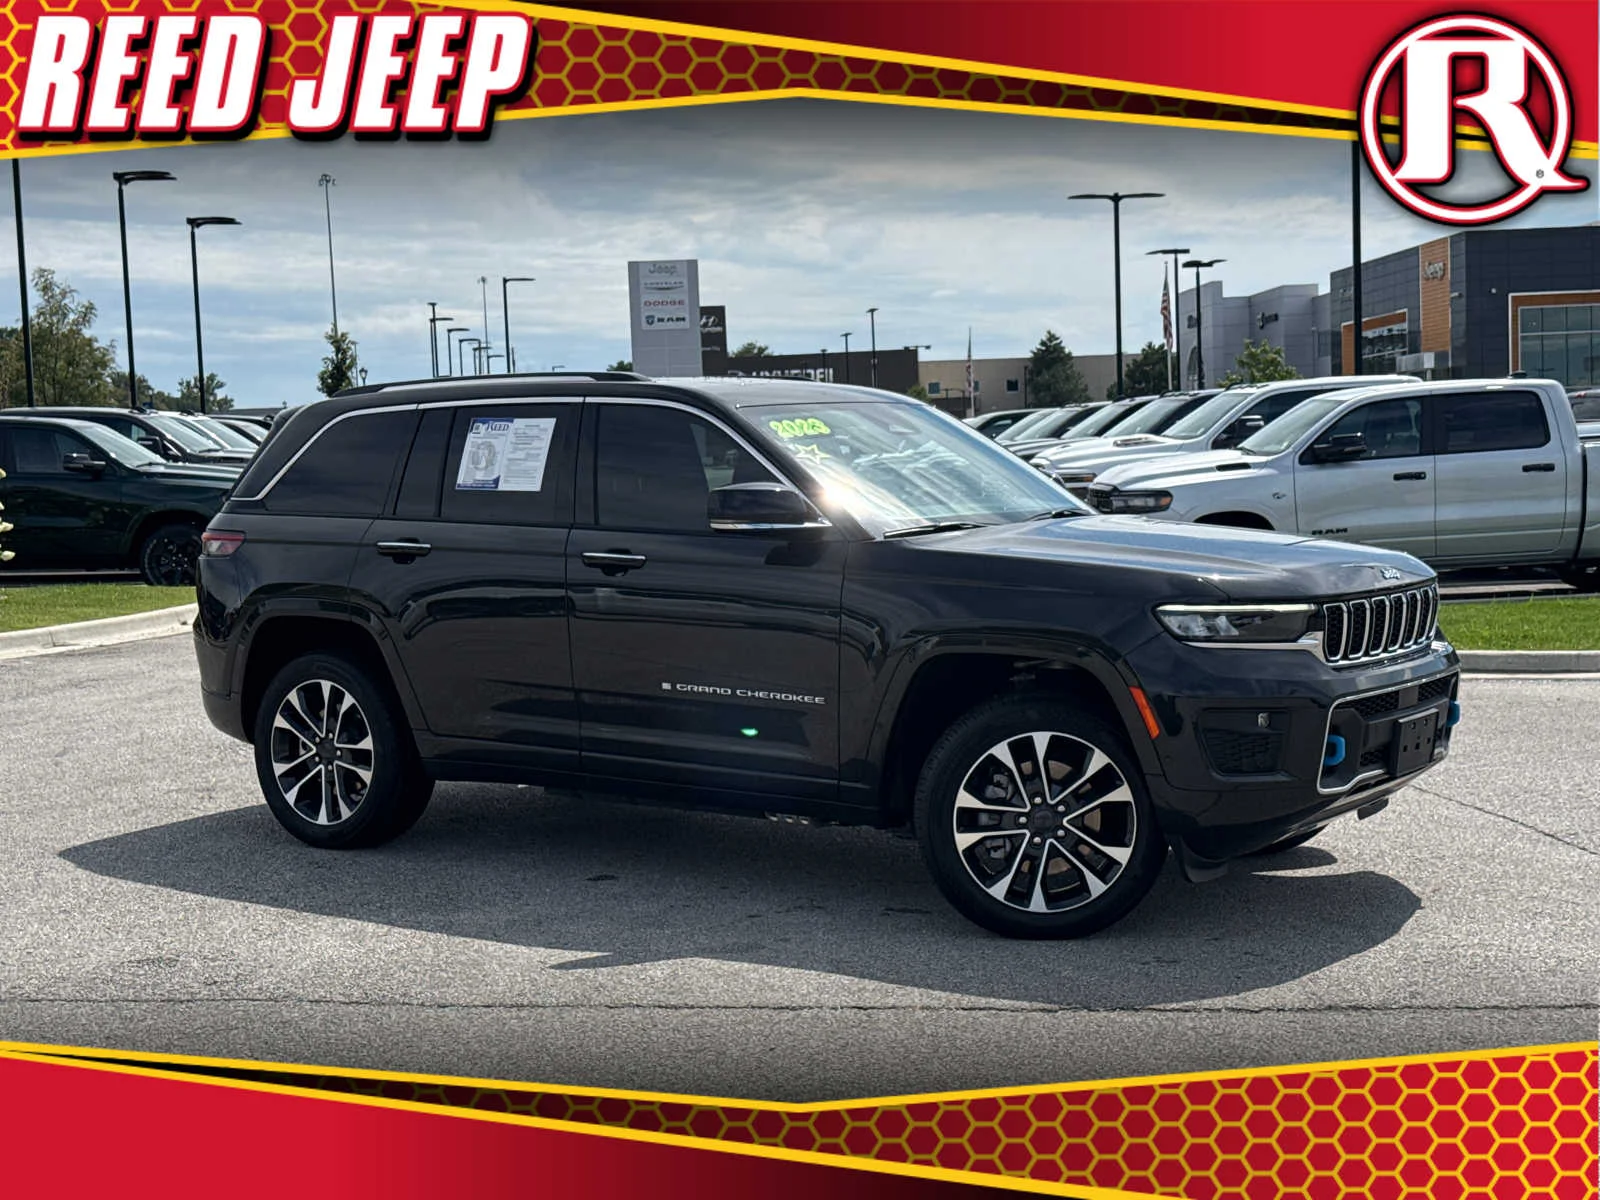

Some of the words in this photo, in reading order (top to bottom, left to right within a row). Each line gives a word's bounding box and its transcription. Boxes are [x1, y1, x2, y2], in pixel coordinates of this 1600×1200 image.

[643, 299, 685, 308] DODGE
[657, 316, 686, 324] RAM
[1311, 527, 1349, 536] RAM
[676, 683, 732, 696] GRAND
[735, 688, 826, 705] CHEROKEE
